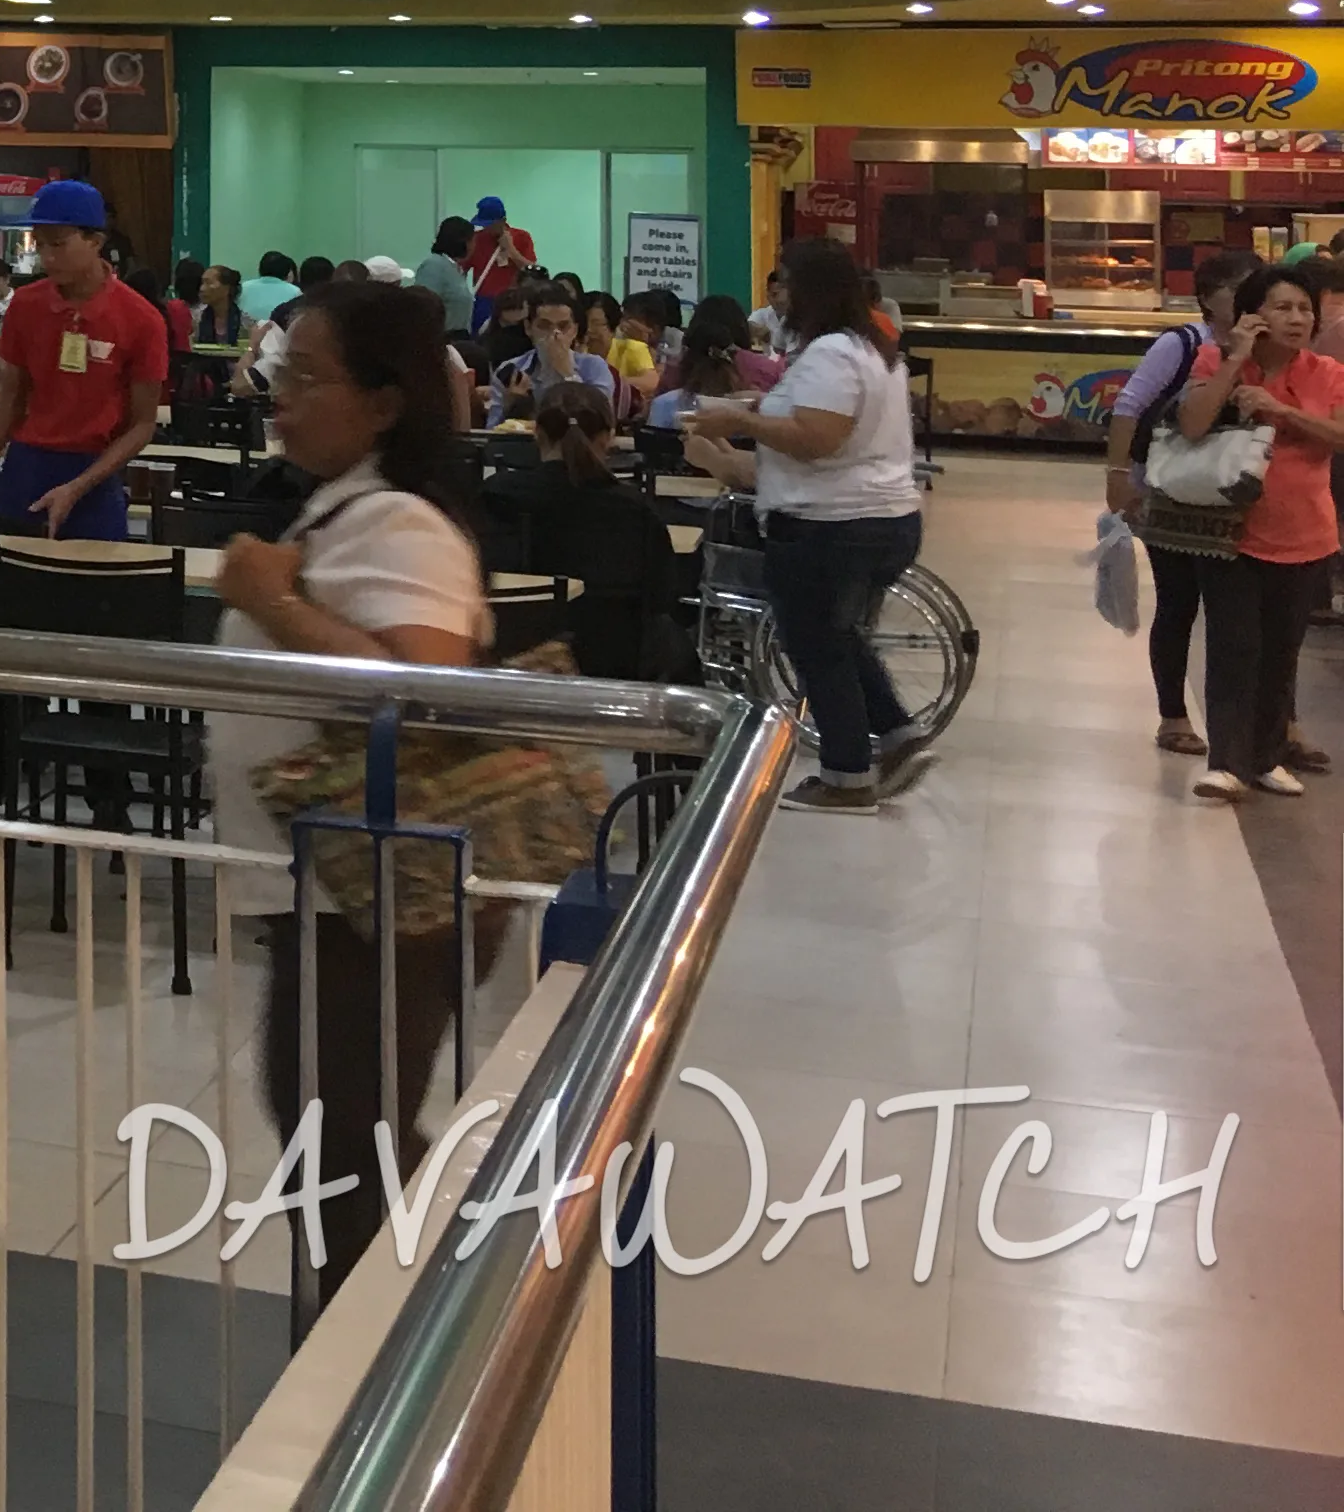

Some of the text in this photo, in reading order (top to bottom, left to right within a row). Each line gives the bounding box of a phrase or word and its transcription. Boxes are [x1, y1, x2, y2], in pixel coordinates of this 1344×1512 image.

[1132, 58, 1295, 81] Pritong
[1052, 63, 1296, 123] Manok
[648, 228, 685, 240] Please
[641, 243, 672, 252] come
[632, 255, 697, 267] more tables
[636, 267, 693, 279] and chairs
